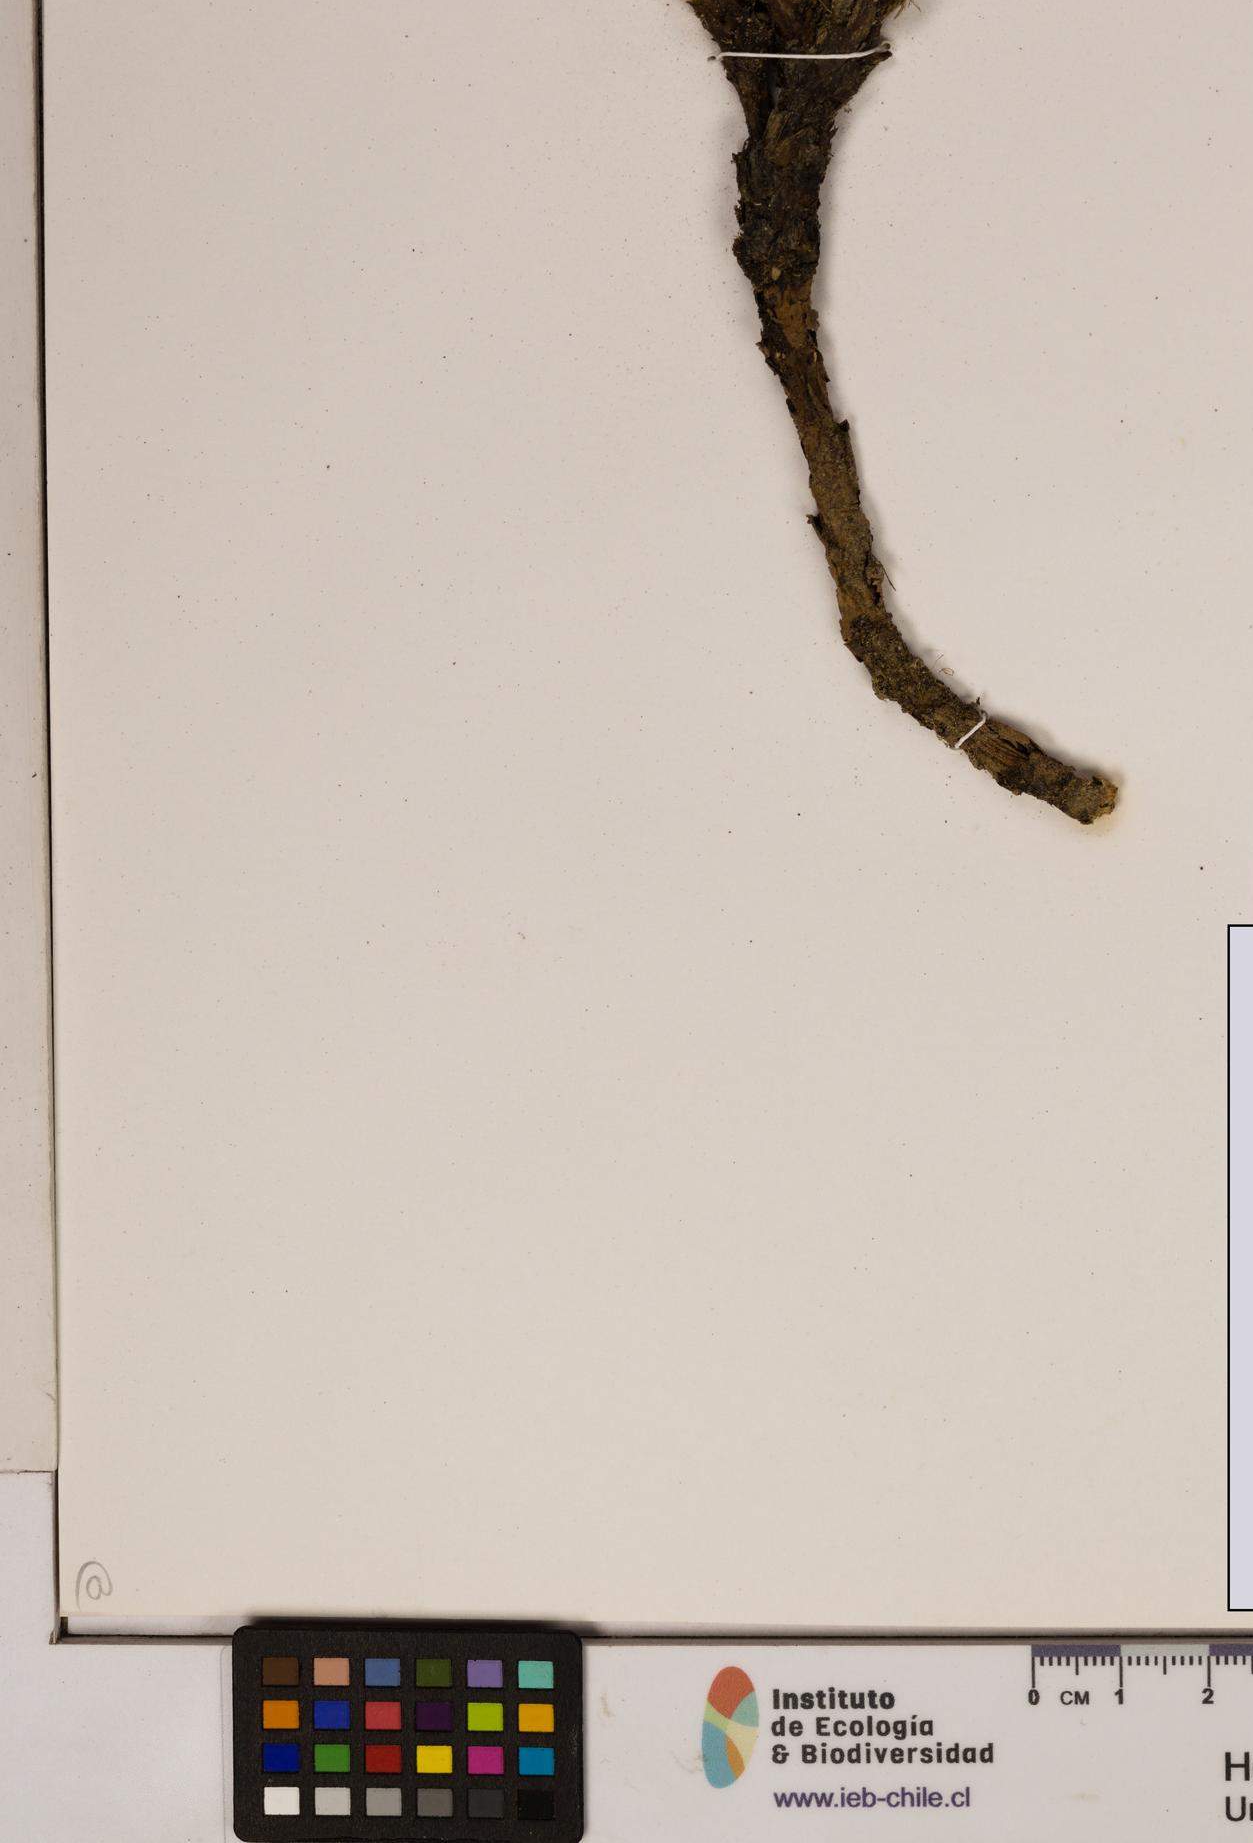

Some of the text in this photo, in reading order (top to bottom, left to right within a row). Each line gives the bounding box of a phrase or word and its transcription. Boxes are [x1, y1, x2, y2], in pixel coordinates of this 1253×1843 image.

[772, 1688, 896, 1711] Instituto
[1027, 1688, 1041, 1706] 0
[1060, 1690, 1090, 1706] CM
[1114, 1688, 1125, 1706] 1
[1202, 1687, 1215, 1705] 2
[771, 1714, 935, 1740] de Ecología
[771, 1742, 995, 1765] & Biodiversidad
[773, 1786, 971, 1809] www.ieb-chile.cl
